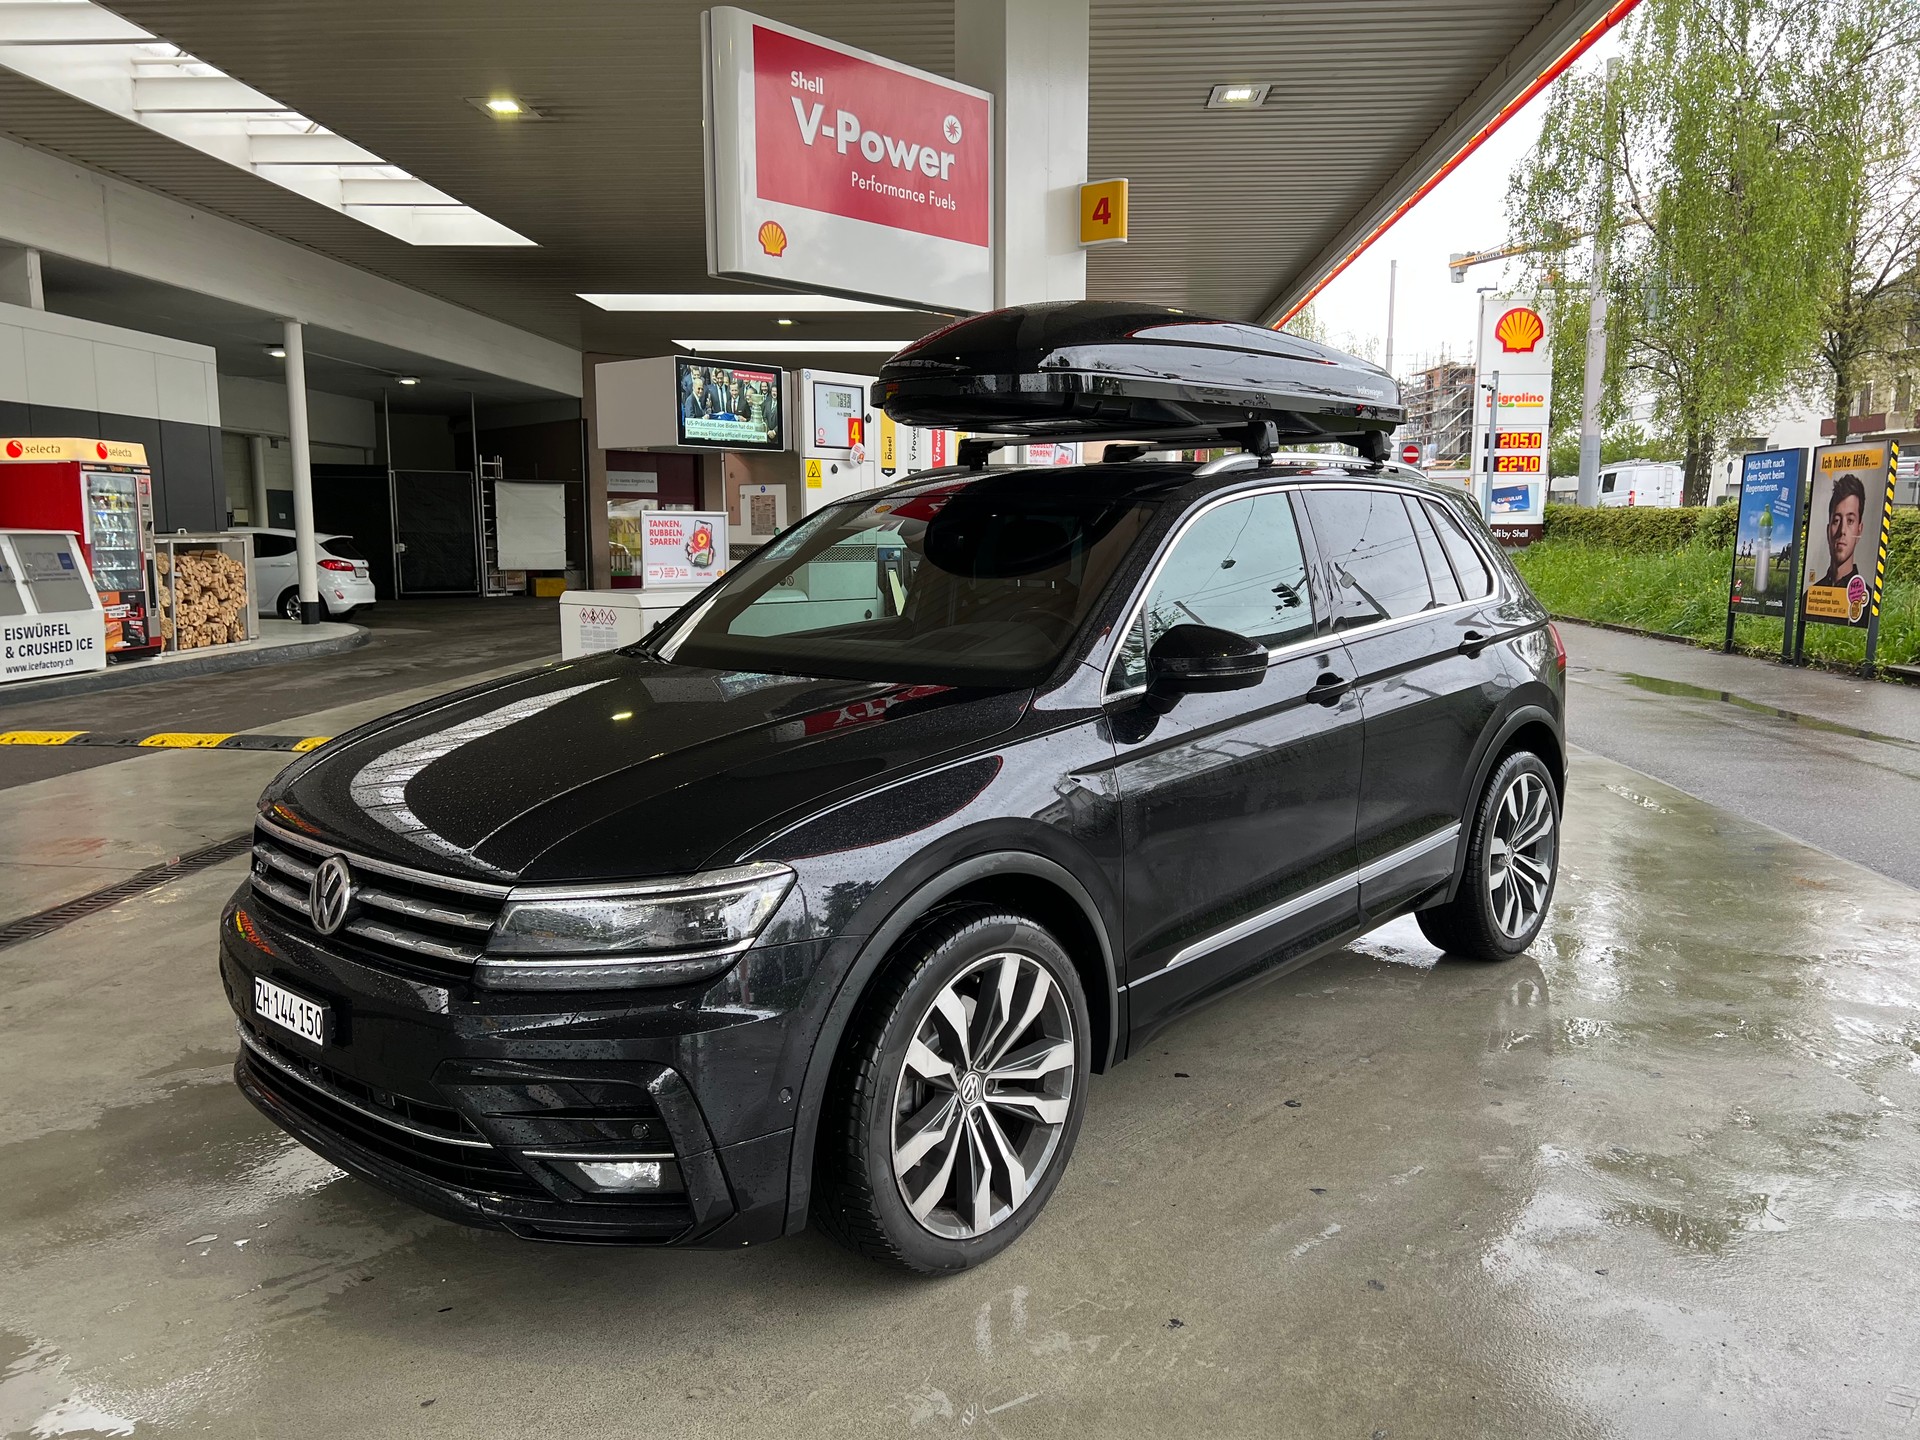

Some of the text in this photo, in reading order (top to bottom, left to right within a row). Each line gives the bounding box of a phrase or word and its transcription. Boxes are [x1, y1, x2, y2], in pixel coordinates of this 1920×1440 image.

[791, 70, 823, 95] Shell
[790, 95, 956, 181] V-Power
[850, 171, 957, 211] Performance Fuels
[1092, 197, 1111, 225] 4
[851, 422, 860, 444] 4
[1500, 433, 1540, 448] 205.0
[25, 446, 61, 454] selecta
[109, 449, 132, 458] selecta
[1498, 456, 1539, 472] 224.0
[1748, 458, 1785, 470] Milch hilft nach
[1822, 456, 1832, 469] Ich
[1834, 456, 1850, 468] holte
[1747, 470, 1785, 483] dem Sport beim
[1745, 483, 1778, 495] Regenerieren.
[1497, 495, 1522, 503] CUMULUS
[649, 520, 682, 528] TANKEN,
[649, 529, 685, 537] RUBBELN,
[1502, 529, 1511, 540] by
[1512, 529, 1529, 538] Shell
[4, 622, 71, 641] EISWÜRFEL
[5, 638, 93, 659] & CRUSHED ICE
[6, 658, 74, 674] www.icefactory.ch
